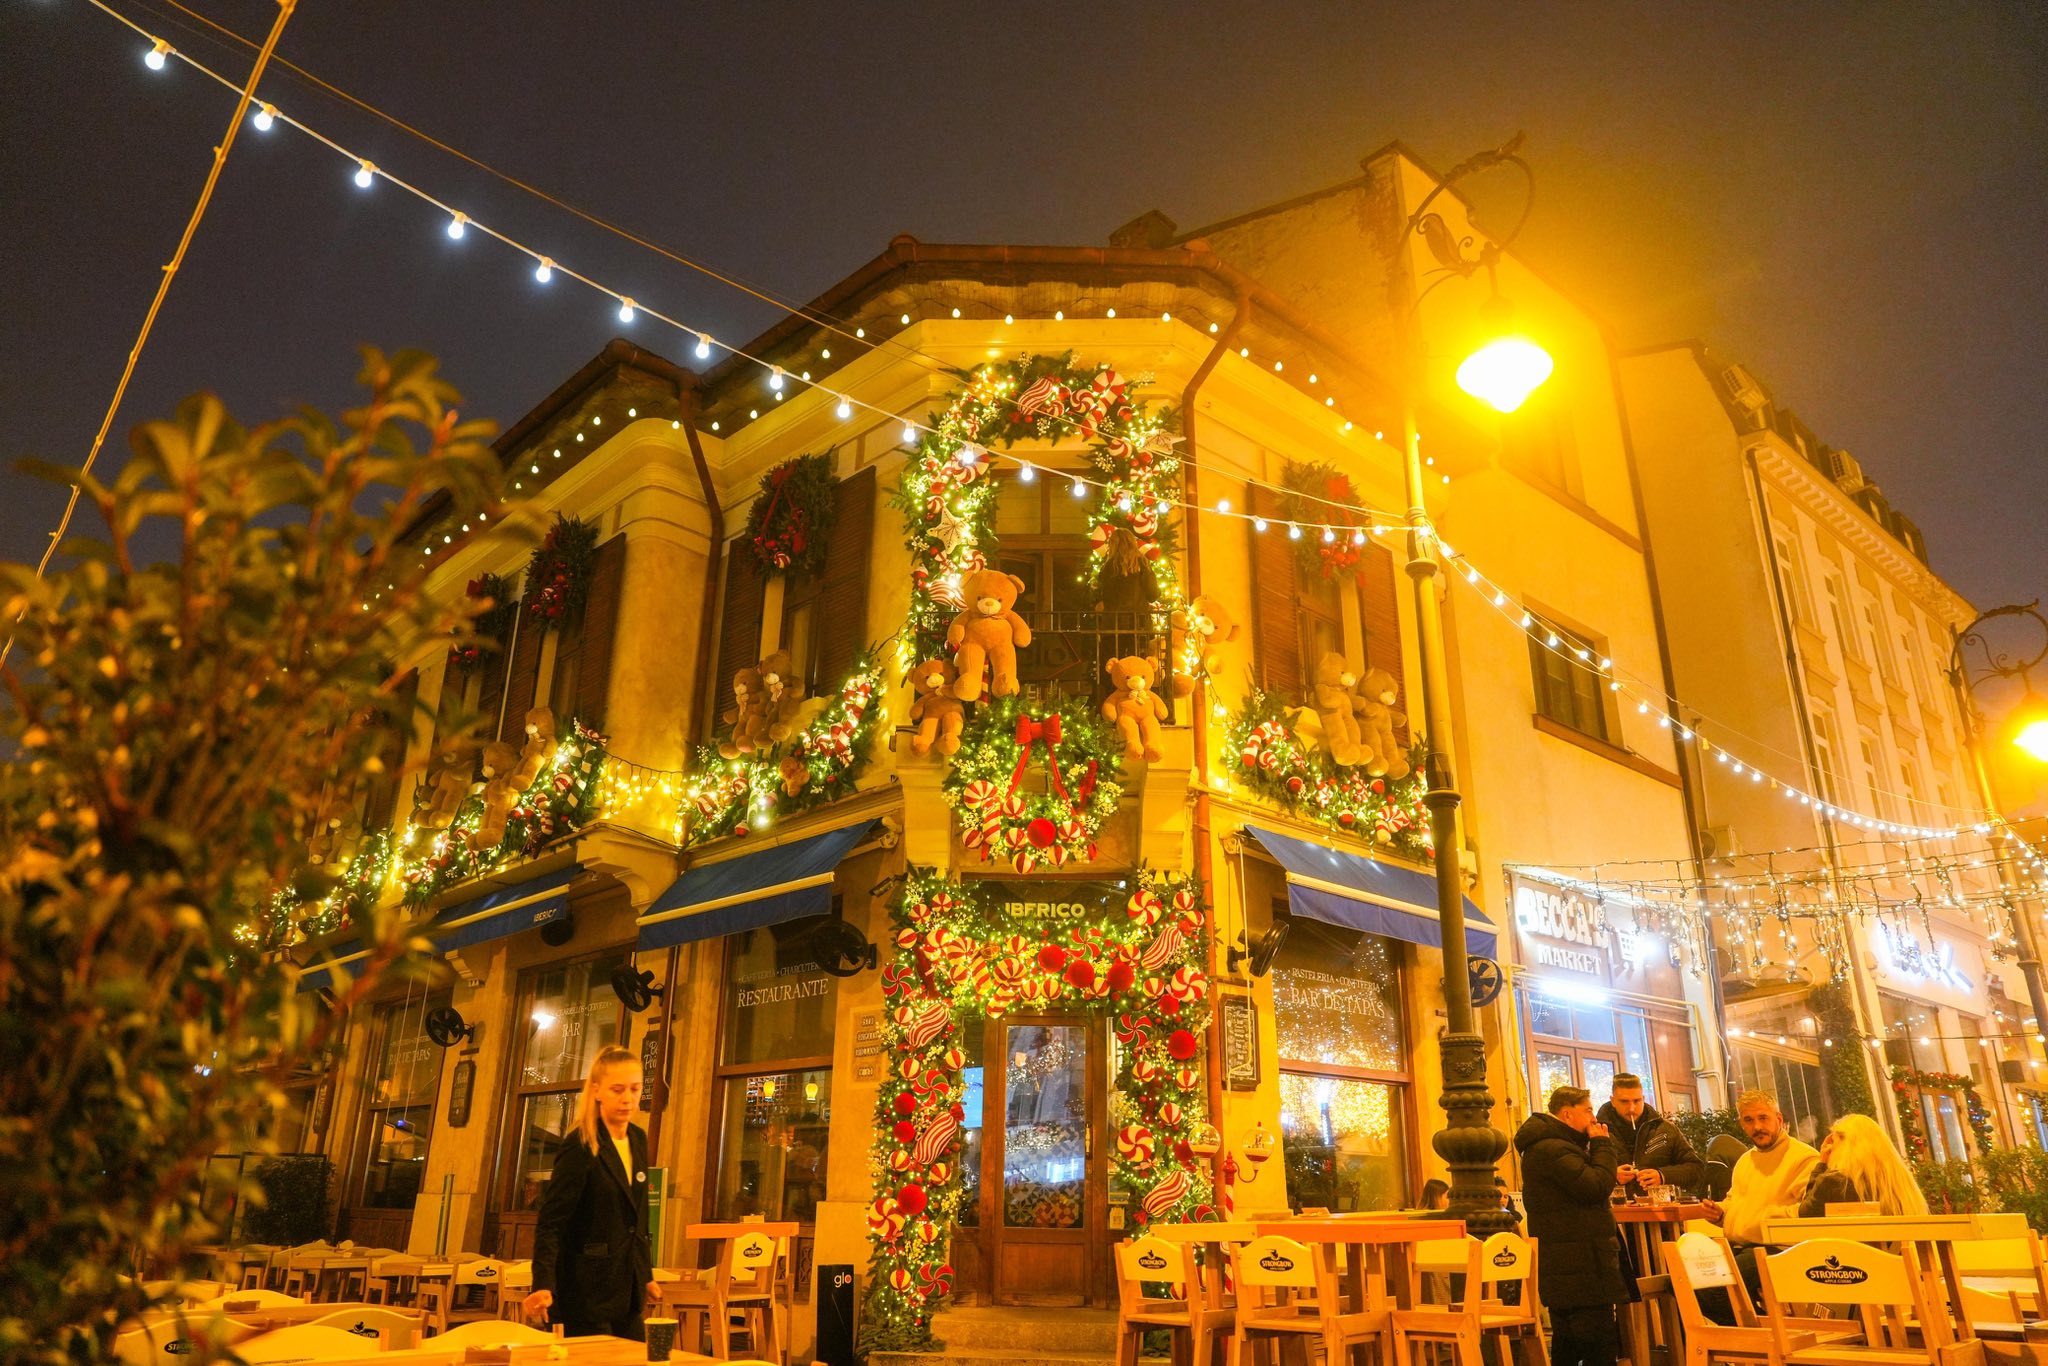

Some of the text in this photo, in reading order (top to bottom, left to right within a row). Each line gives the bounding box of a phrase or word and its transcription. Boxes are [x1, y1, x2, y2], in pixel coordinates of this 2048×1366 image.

[1516, 886, 1609, 949] BECCA'S
[1537, 943, 1602, 975] MARKET
[1291, 987, 1386, 1018] BAR DE TAPAS
[561, 1022, 581, 1038] BAR
[834, 1271, 852, 1288] glo
[1809, 1270, 1863, 1279] STRONGBOW
